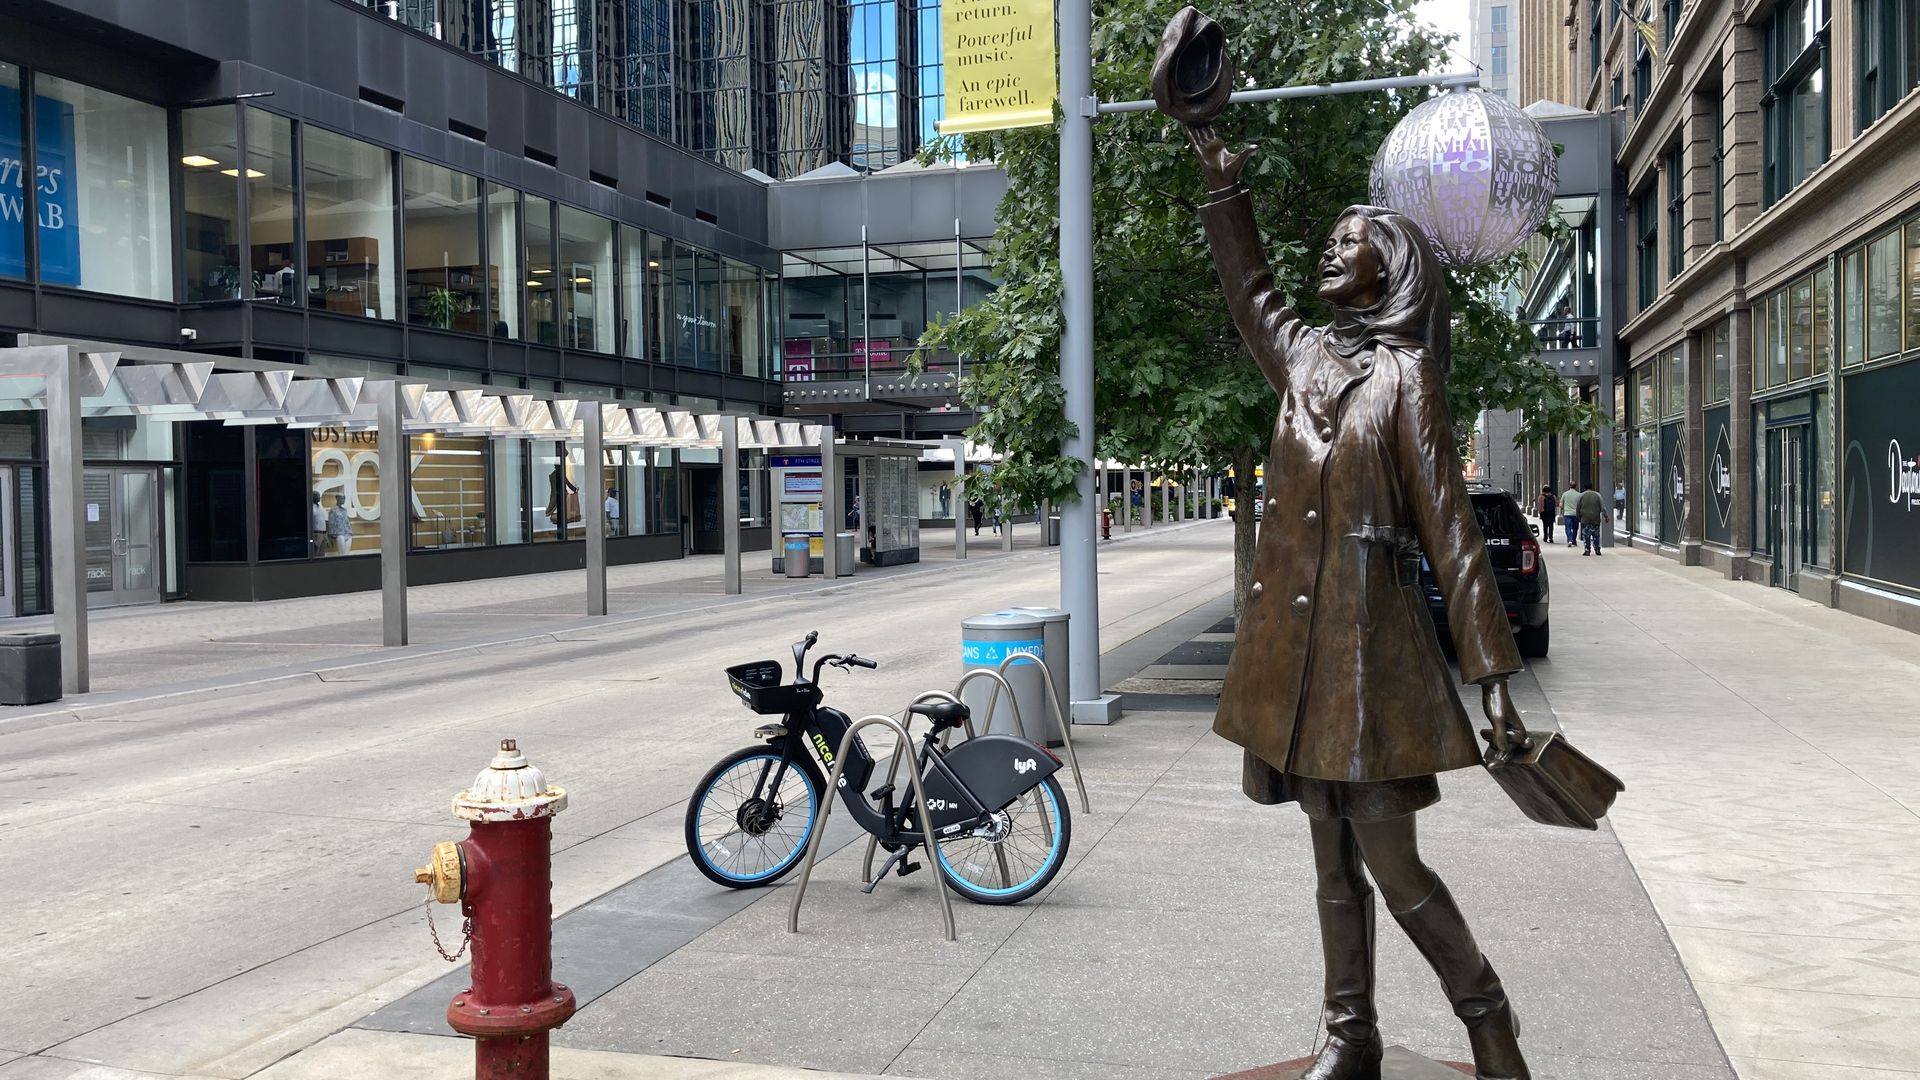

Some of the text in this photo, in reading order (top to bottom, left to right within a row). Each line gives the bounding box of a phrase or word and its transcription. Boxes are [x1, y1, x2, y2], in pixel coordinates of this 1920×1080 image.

[956, 5, 1017, 21] return.
[957, 25, 1032, 48] Powerful
[958, 48, 1013, 66] music.
[960, 74, 1021, 93] An epic
[960, 89, 1034, 111] farewell.
[1433, 139, 1487, 153] WHAT
[1495, 160, 1539, 173] NO
[1484, 538, 1510, 546] ICE
[87, 568, 106, 578] rack
[1014, 758, 1037, 774] lyft
